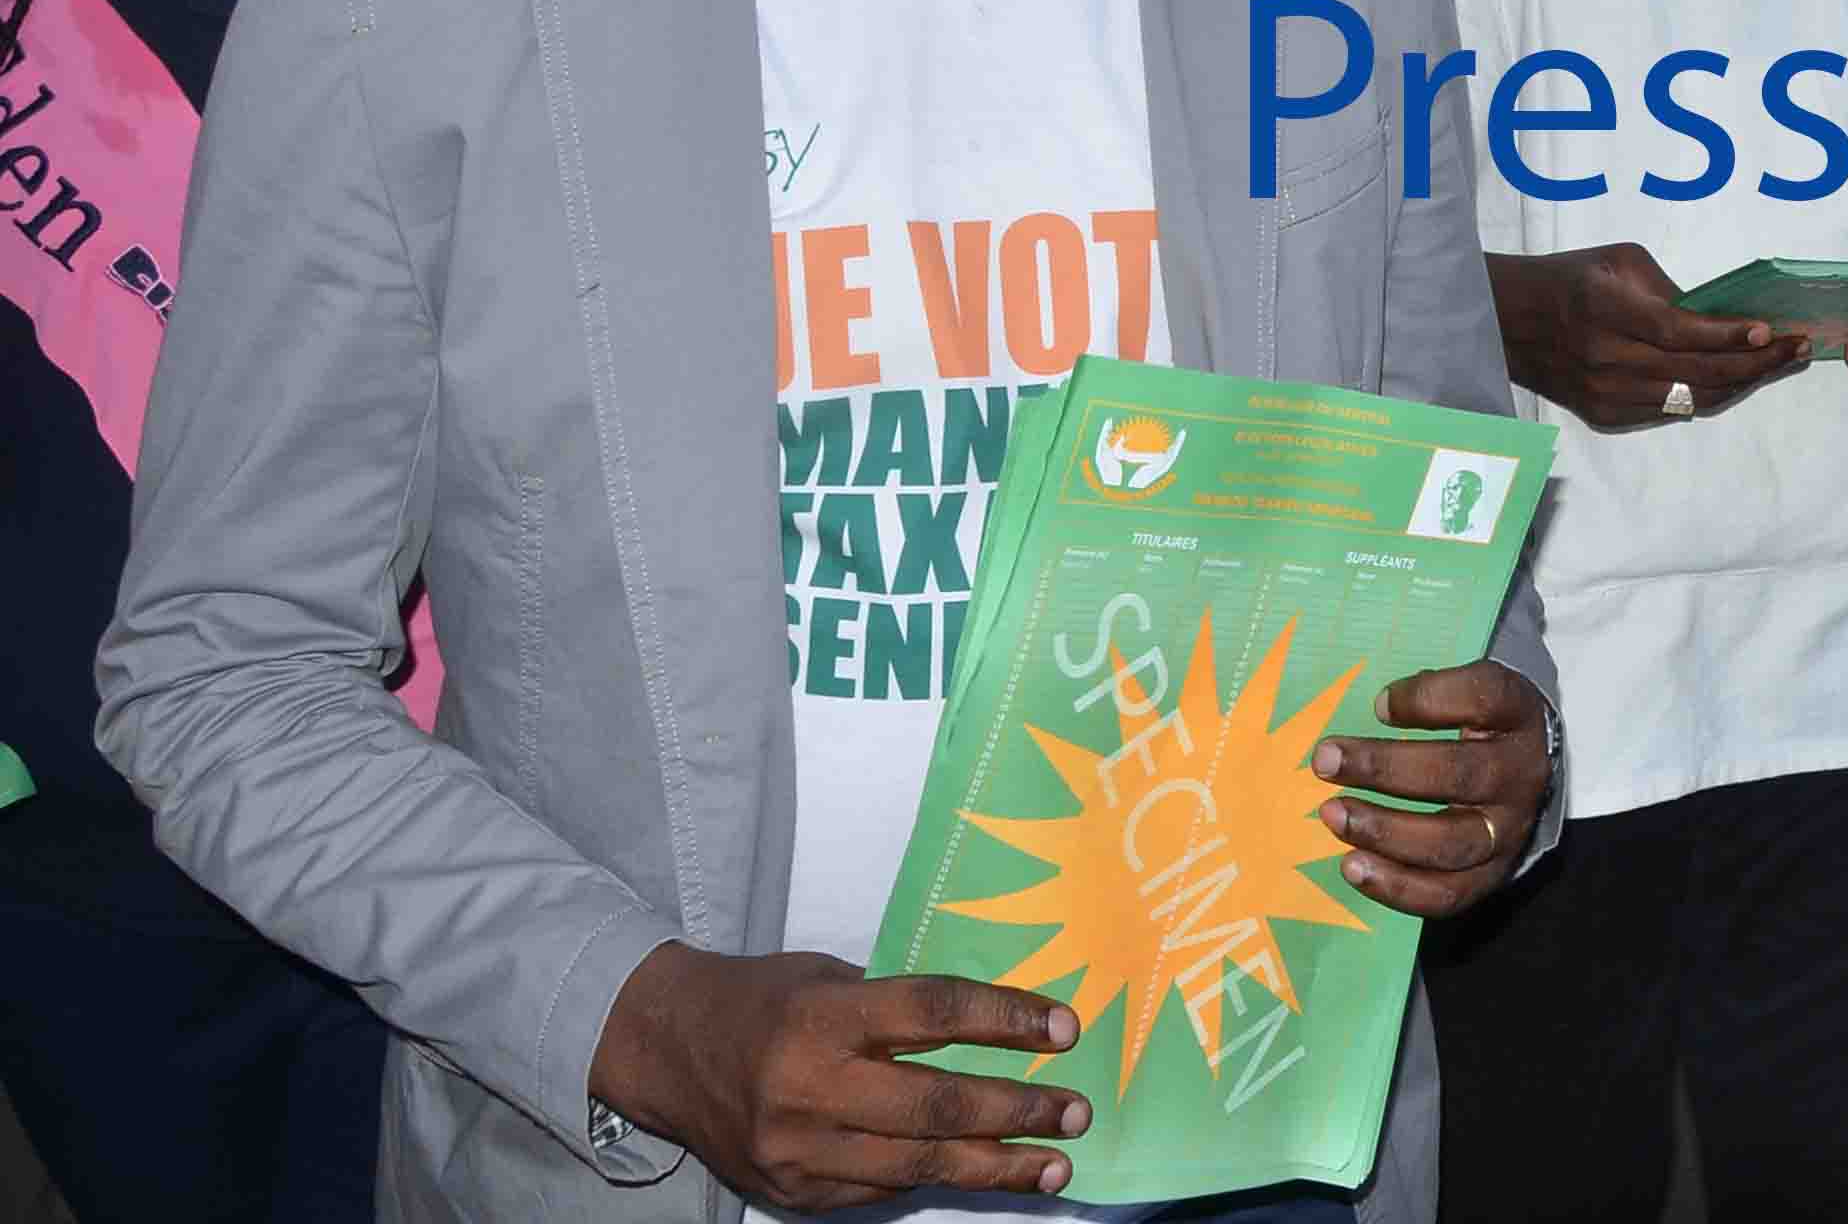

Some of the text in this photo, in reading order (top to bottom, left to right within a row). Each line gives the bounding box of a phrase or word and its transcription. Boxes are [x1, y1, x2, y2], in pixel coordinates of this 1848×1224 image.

[777, 382, 1050, 487] MAN
[779, 489, 1000, 596] TAX
[1131, 531, 1200, 552] TITULAIRES
[1053, 592, 1306, 1114] SPECIMEN
